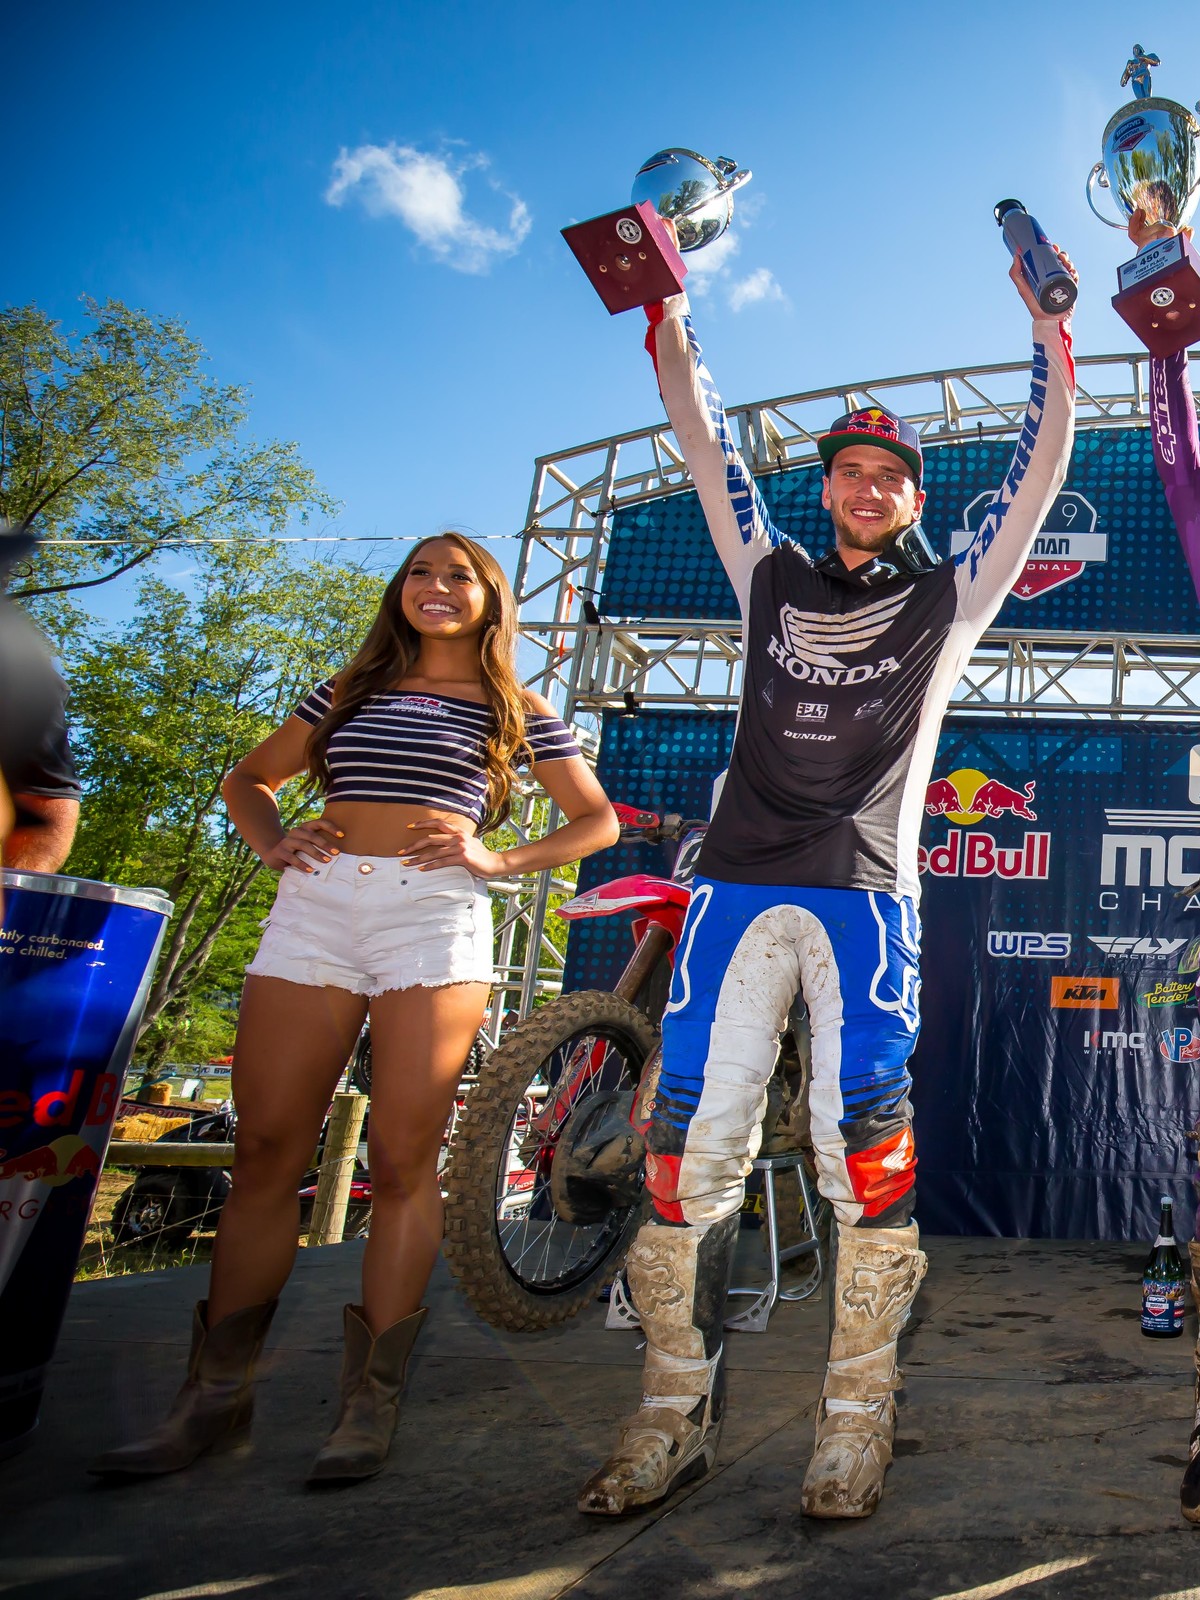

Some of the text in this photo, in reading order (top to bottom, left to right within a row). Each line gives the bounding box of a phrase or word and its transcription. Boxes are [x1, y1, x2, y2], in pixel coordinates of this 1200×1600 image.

[1050, 289, 1069, 304] 94
[1027, 563, 1071, 571] ONAL
[766, 635, 901, 686] HONDA
[783, 730, 837, 742] DUNLOP
[918, 829, 1051, 879] ed Bull
[28, 932, 105, 951] carbonated.
[987, 930, 1072, 958] WPS
[1087, 936, 1189, 954] FLY
[19, 944, 68, 960] chilled.
[1063, 985, 1107, 1001] KTM
[1155, 982, 1195, 994] Battery
[1144, 992, 1188, 1008] Tender
[1084, 1030, 1145, 1049] KMC
[1162, 1028, 1192, 1061] VP
